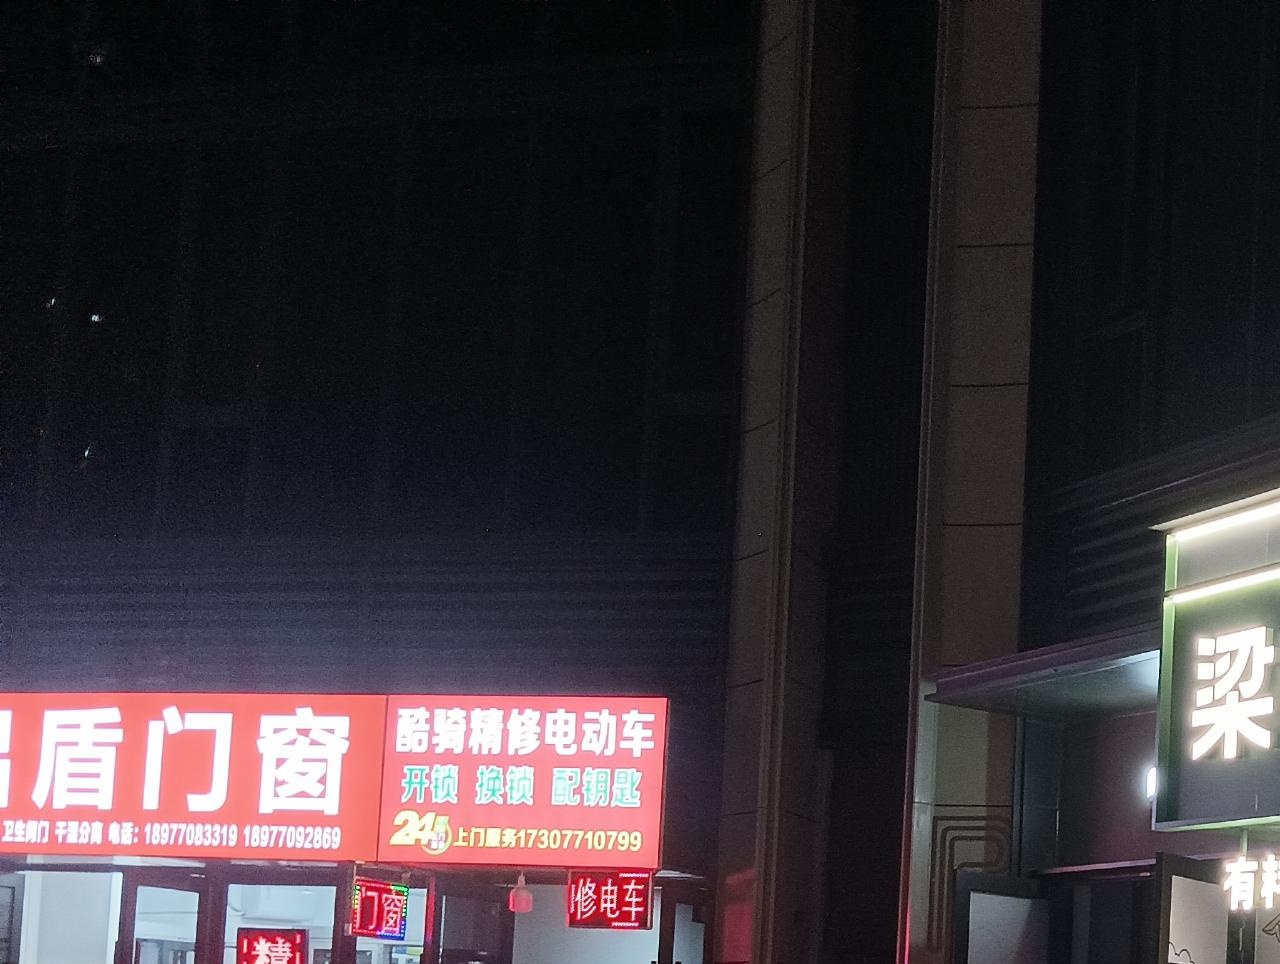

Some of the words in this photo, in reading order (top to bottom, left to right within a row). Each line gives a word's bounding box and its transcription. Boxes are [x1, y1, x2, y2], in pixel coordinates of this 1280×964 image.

[395, 707, 655, 758] 酷骑精修电动车
[401, 764, 460, 804] 开锁
[475, 764, 535, 806] 换锁
[551, 766, 643, 808] 配钥匙
[144, 822, 238, 849] 18977083319
[243, 825, 341, 850] 18977092869
[355, 885, 403, 935] 门窗
[576, 878, 644, 920] 修电车
